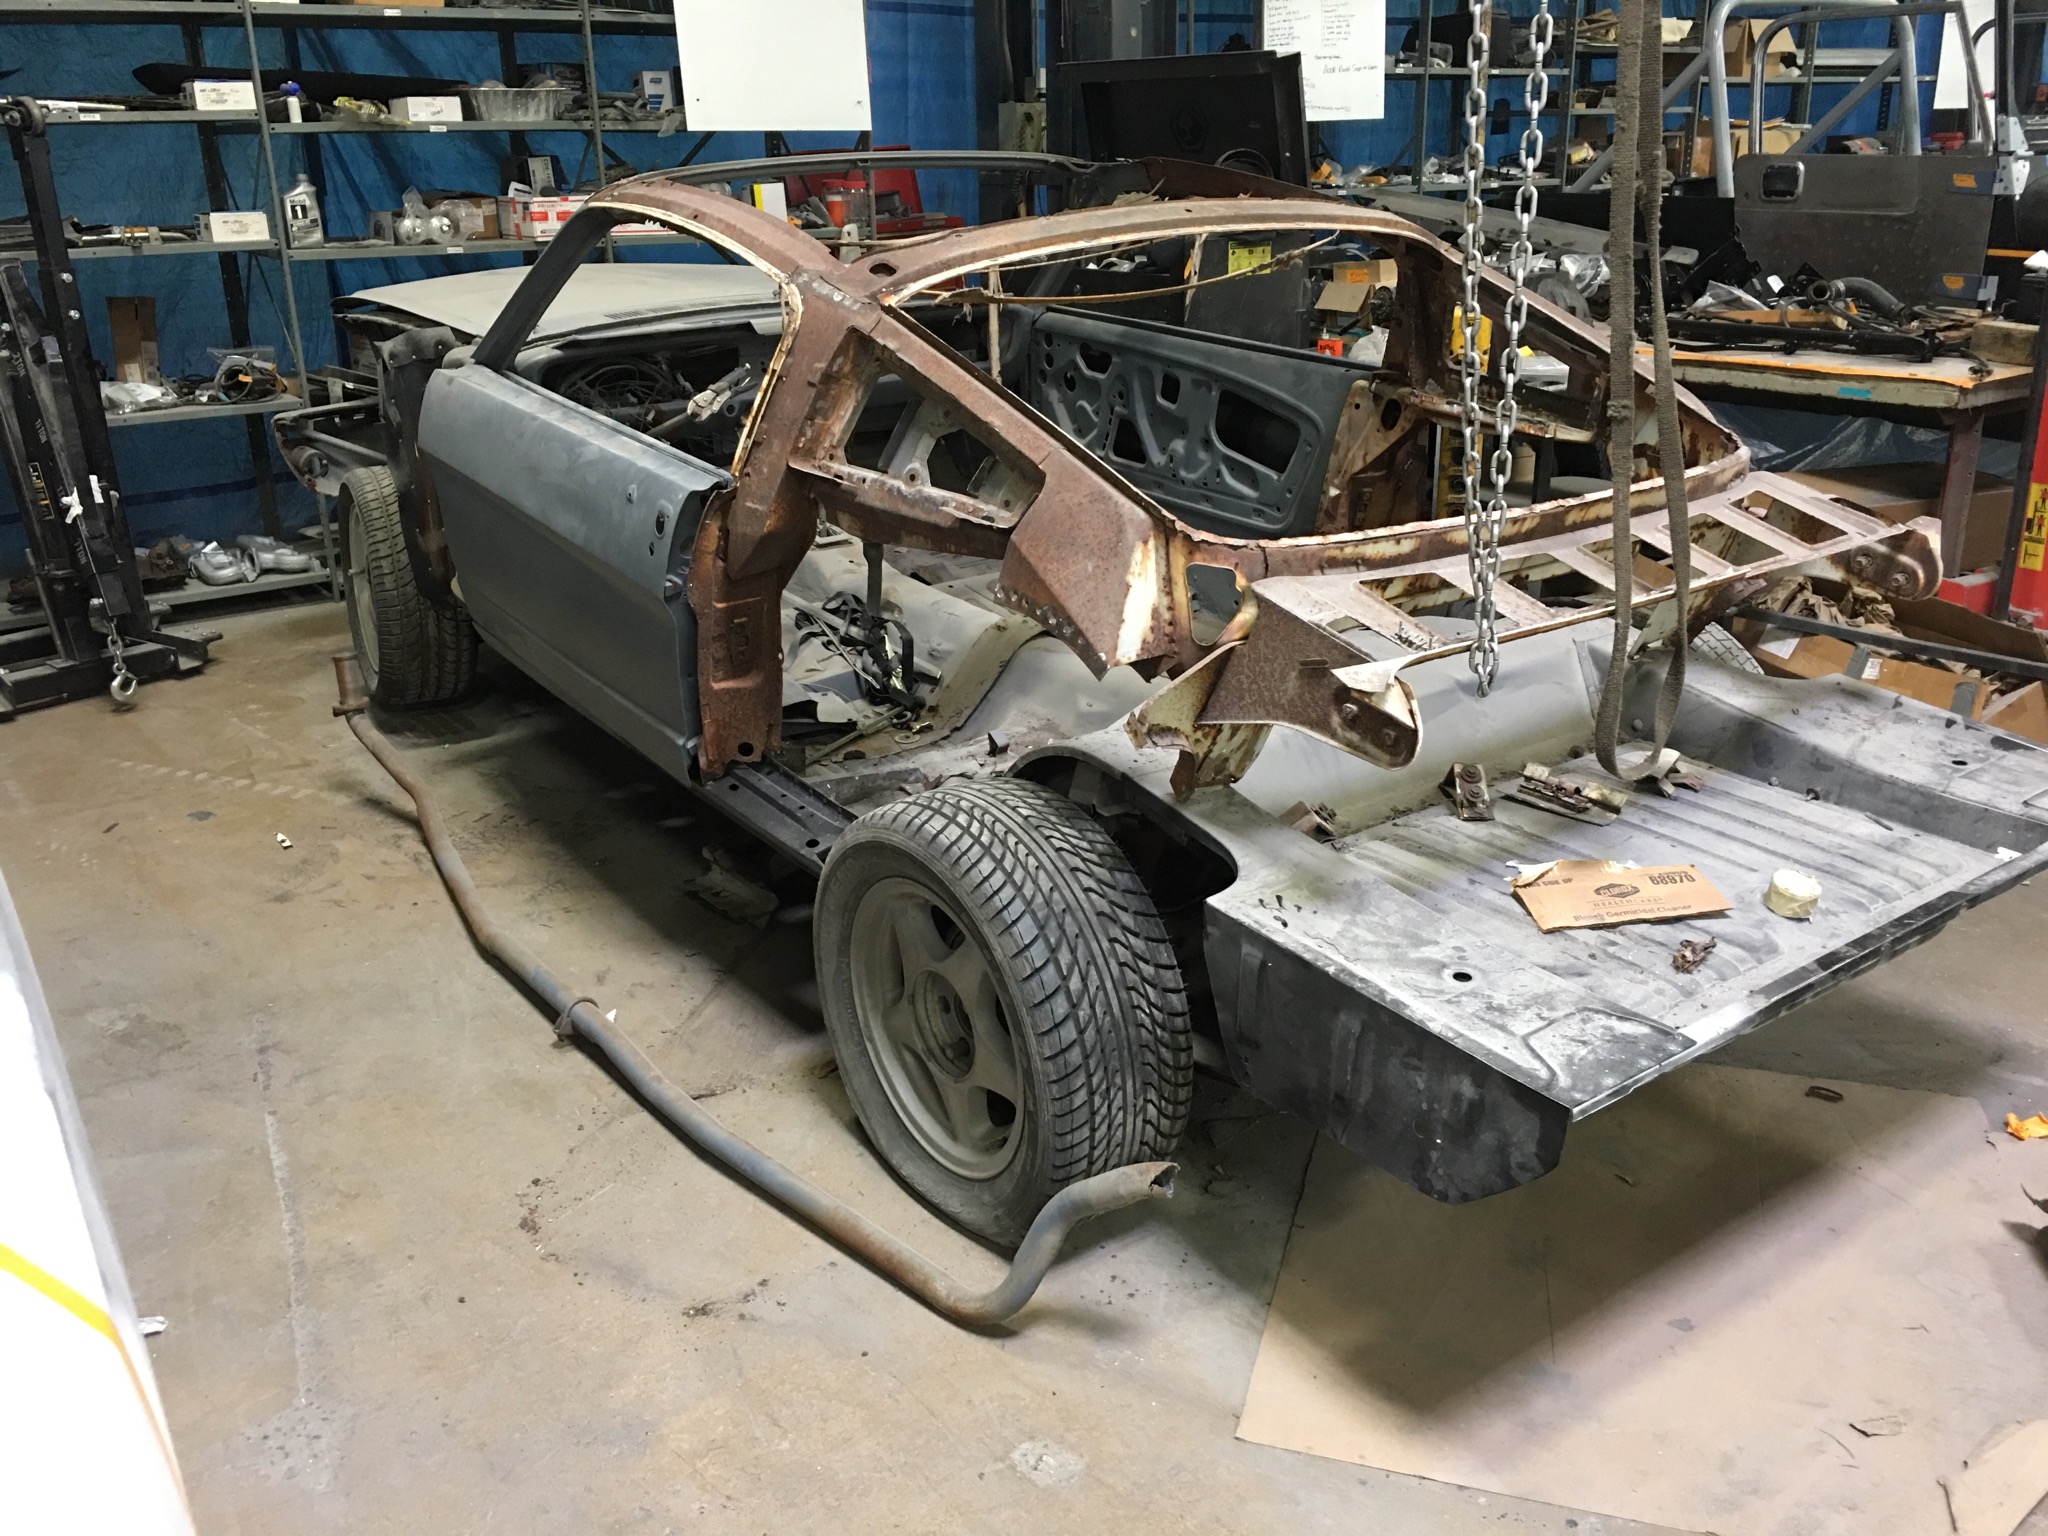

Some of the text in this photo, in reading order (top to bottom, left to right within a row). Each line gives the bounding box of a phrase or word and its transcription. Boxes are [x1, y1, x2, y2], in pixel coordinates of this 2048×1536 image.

[295, 205, 303, 219] 1
[1648, 874, 1696, 885] 68970
[1606, 907, 1656, 918] Germicidal
[1657, 904, 1692, 913] Cleaner
